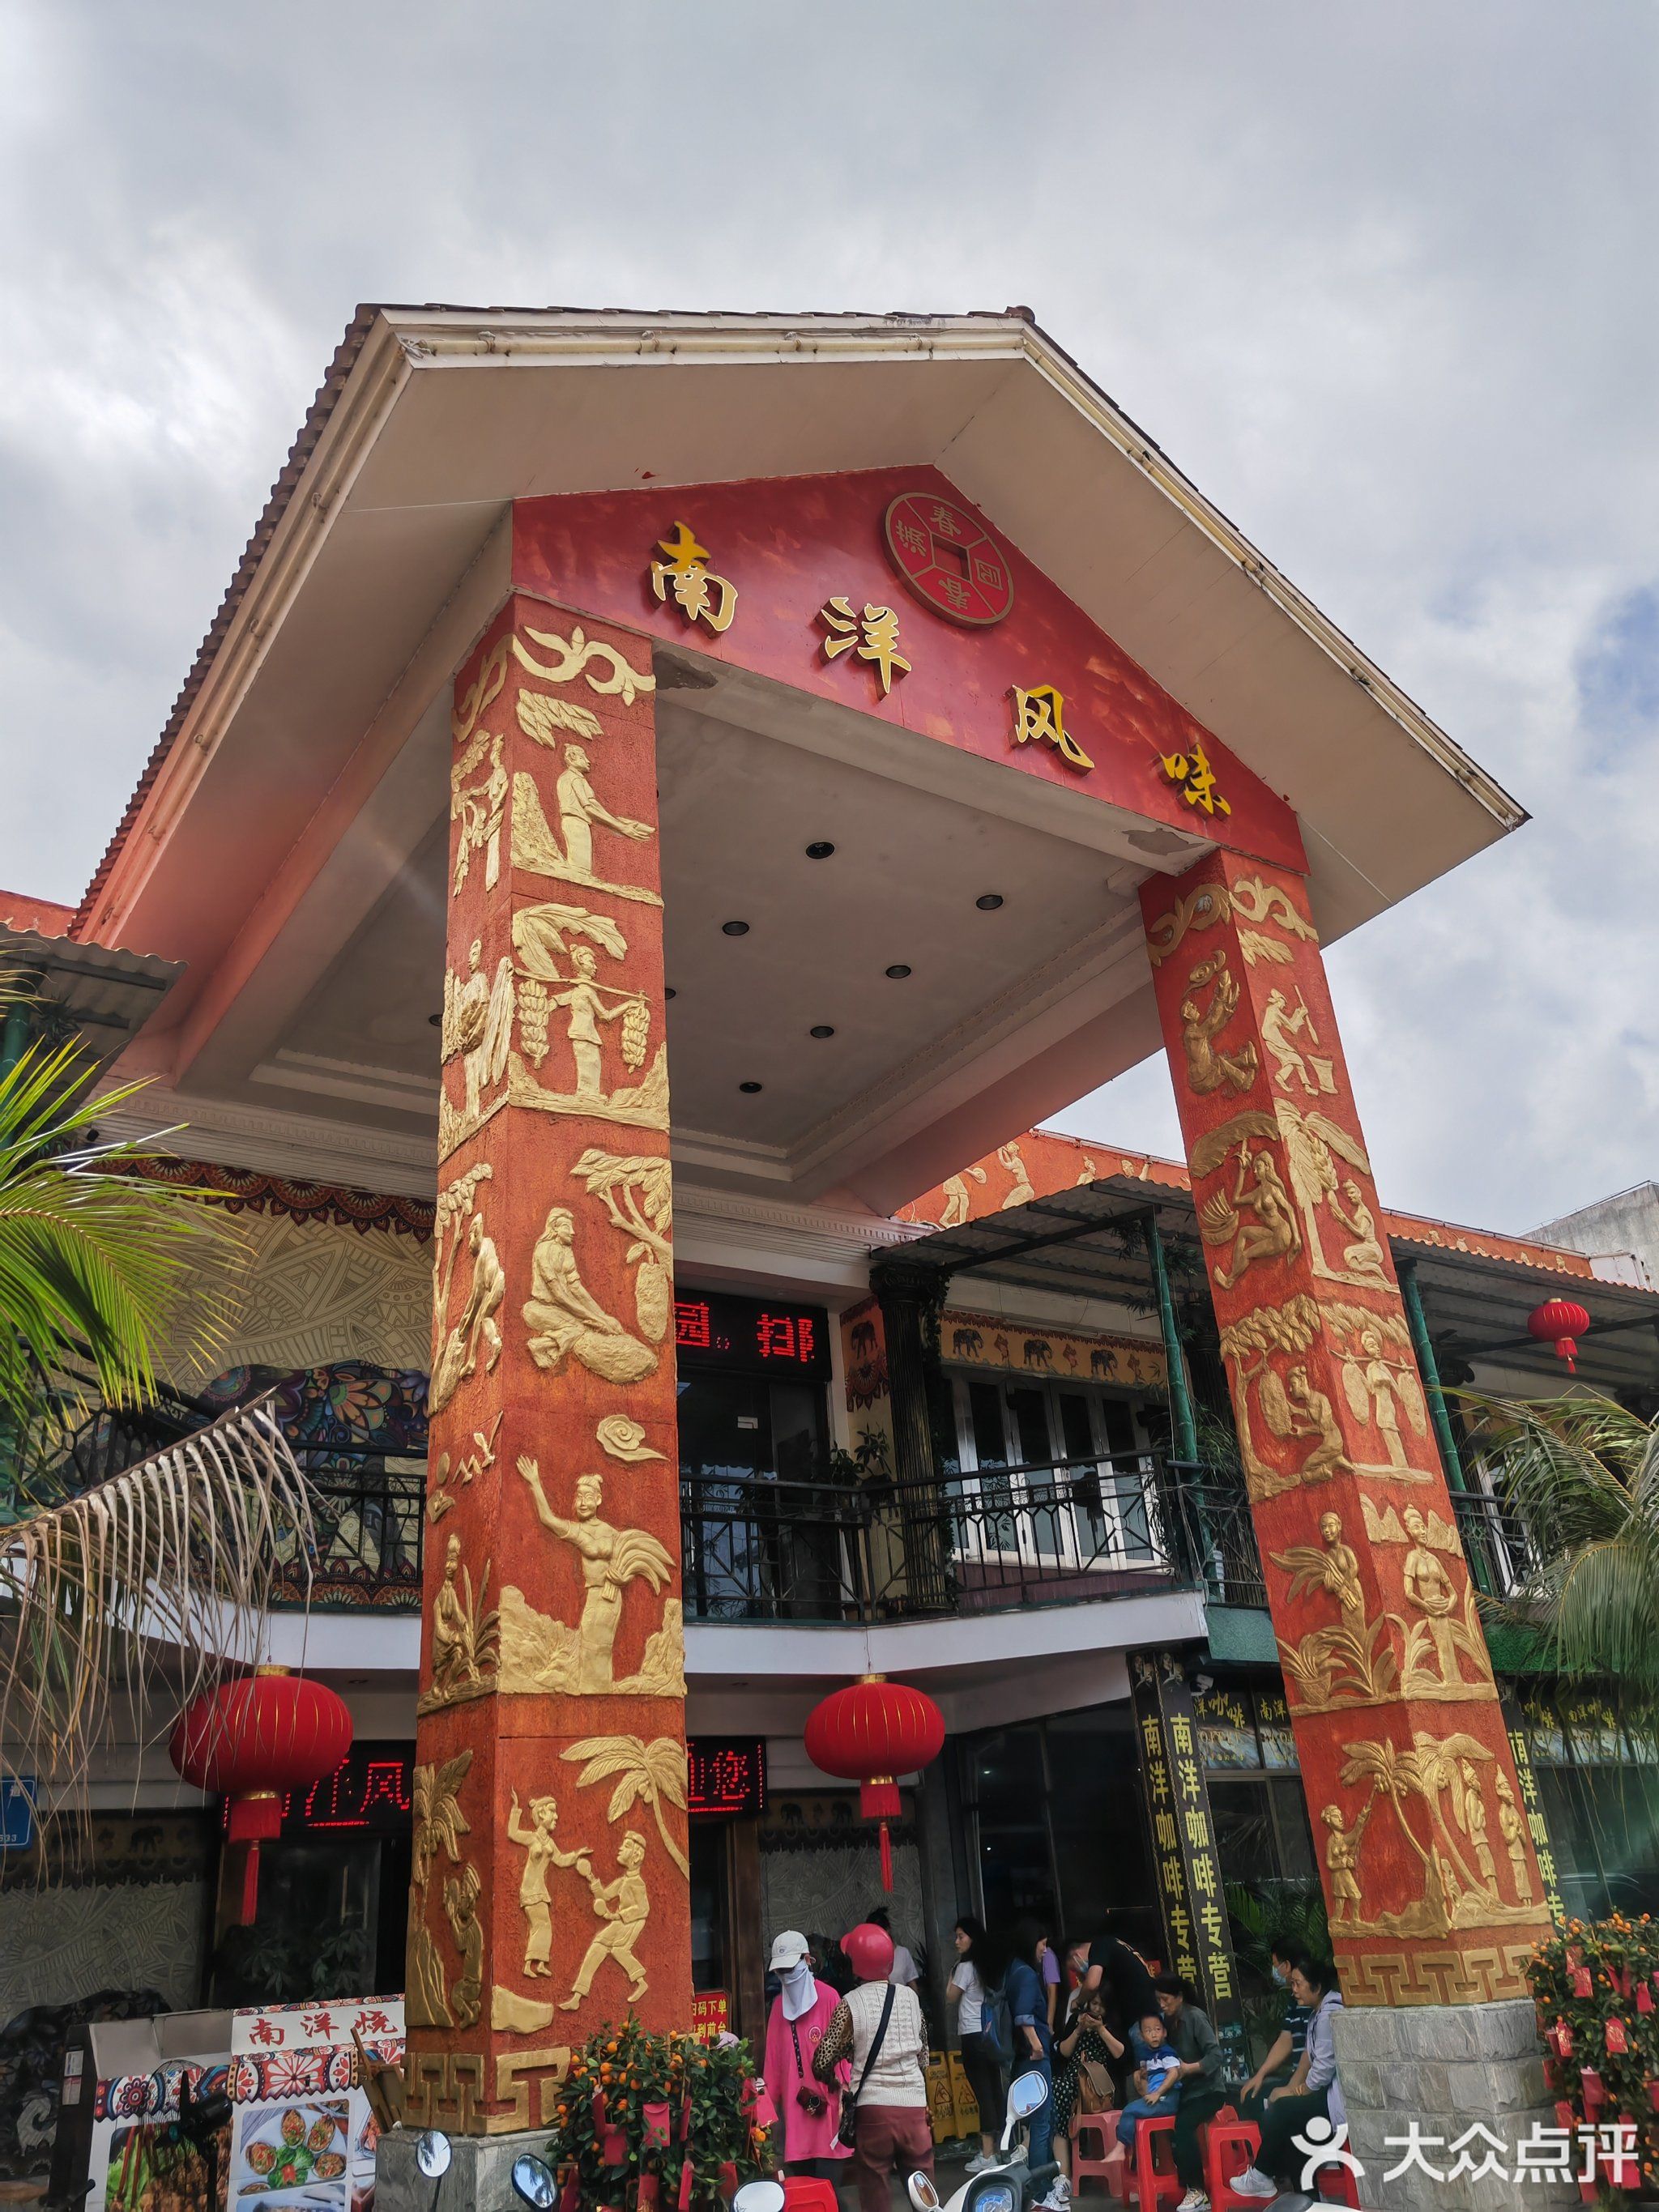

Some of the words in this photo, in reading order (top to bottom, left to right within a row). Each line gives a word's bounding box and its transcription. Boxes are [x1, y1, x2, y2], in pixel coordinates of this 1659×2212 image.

[649, 520, 1232, 820] 南洋风味
[1170, 1712, 1232, 2000] 南洋咖啡专营
[249, 2010, 399, 2047] 南洋烧
[693, 2021, 727, 2039] 到前台
